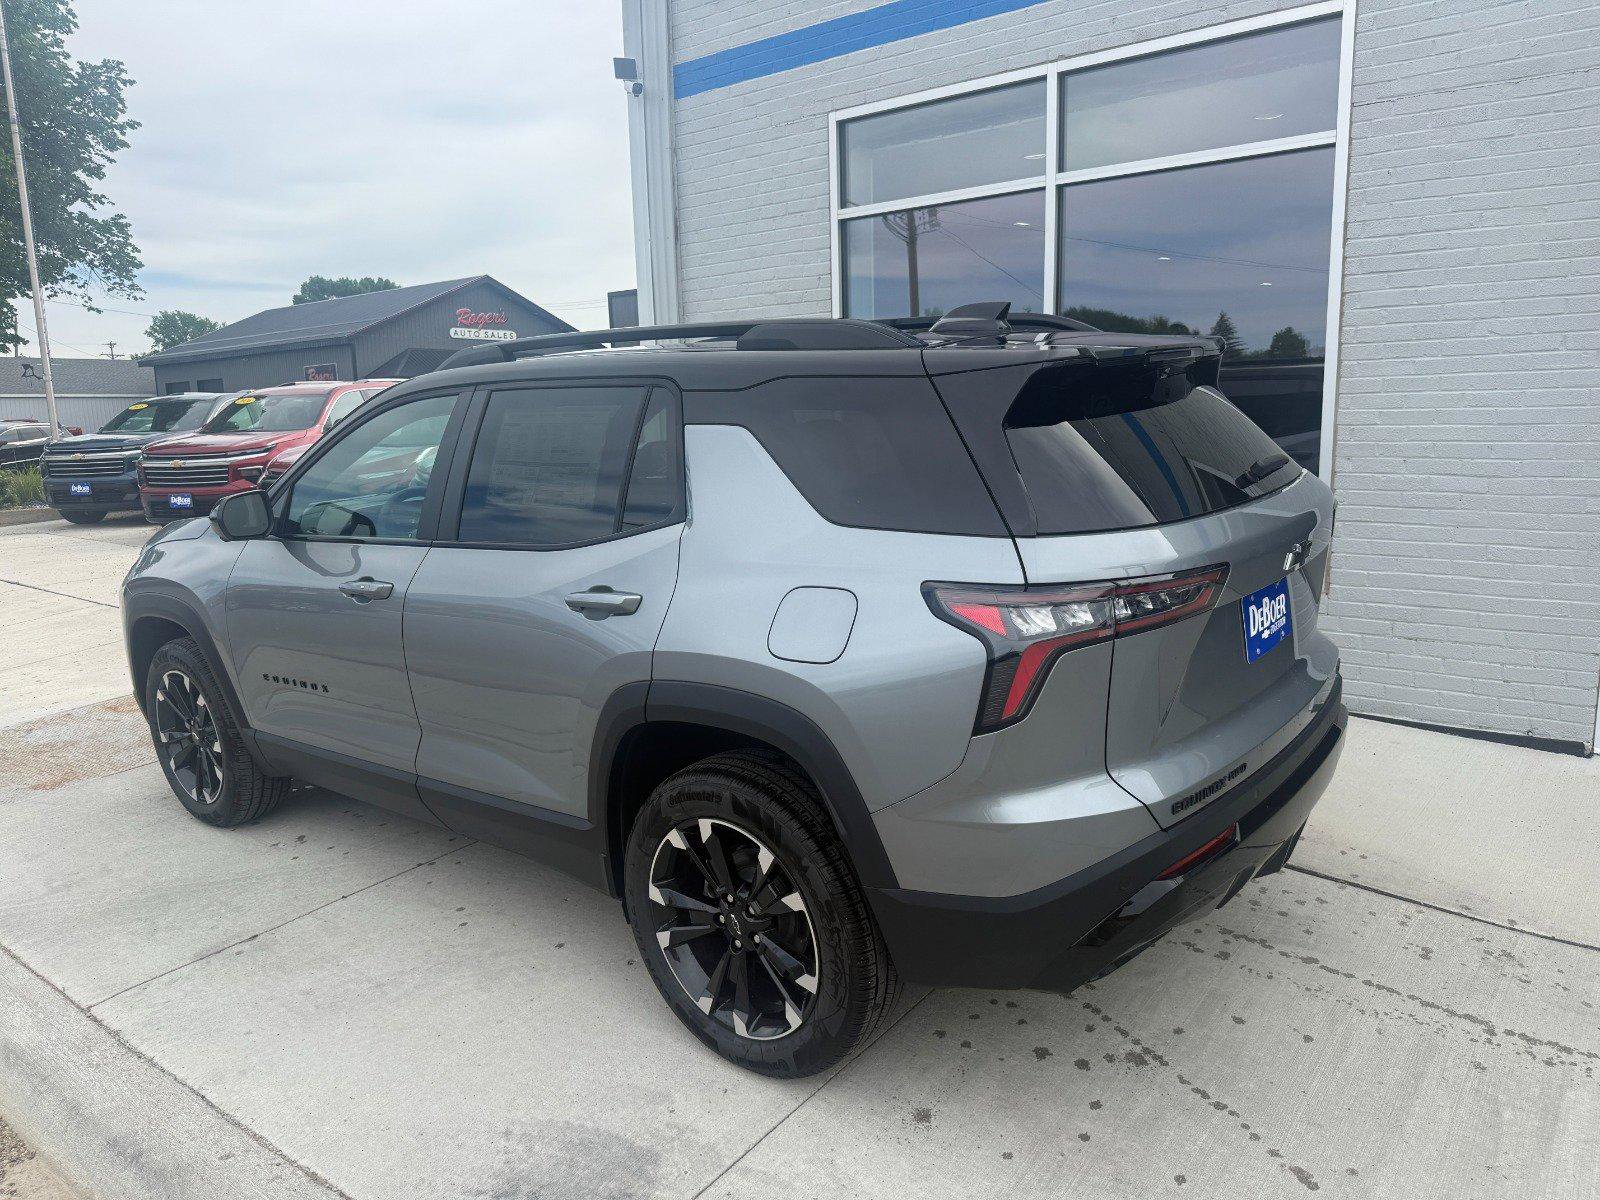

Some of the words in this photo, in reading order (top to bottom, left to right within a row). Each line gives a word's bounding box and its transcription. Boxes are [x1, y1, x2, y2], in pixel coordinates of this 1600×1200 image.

[456, 308, 508, 330] Roger's
[453, 330, 480, 338] AUTO
[484, 331, 514, 340] SALES
[262, 673, 330, 693] EQUINOX
